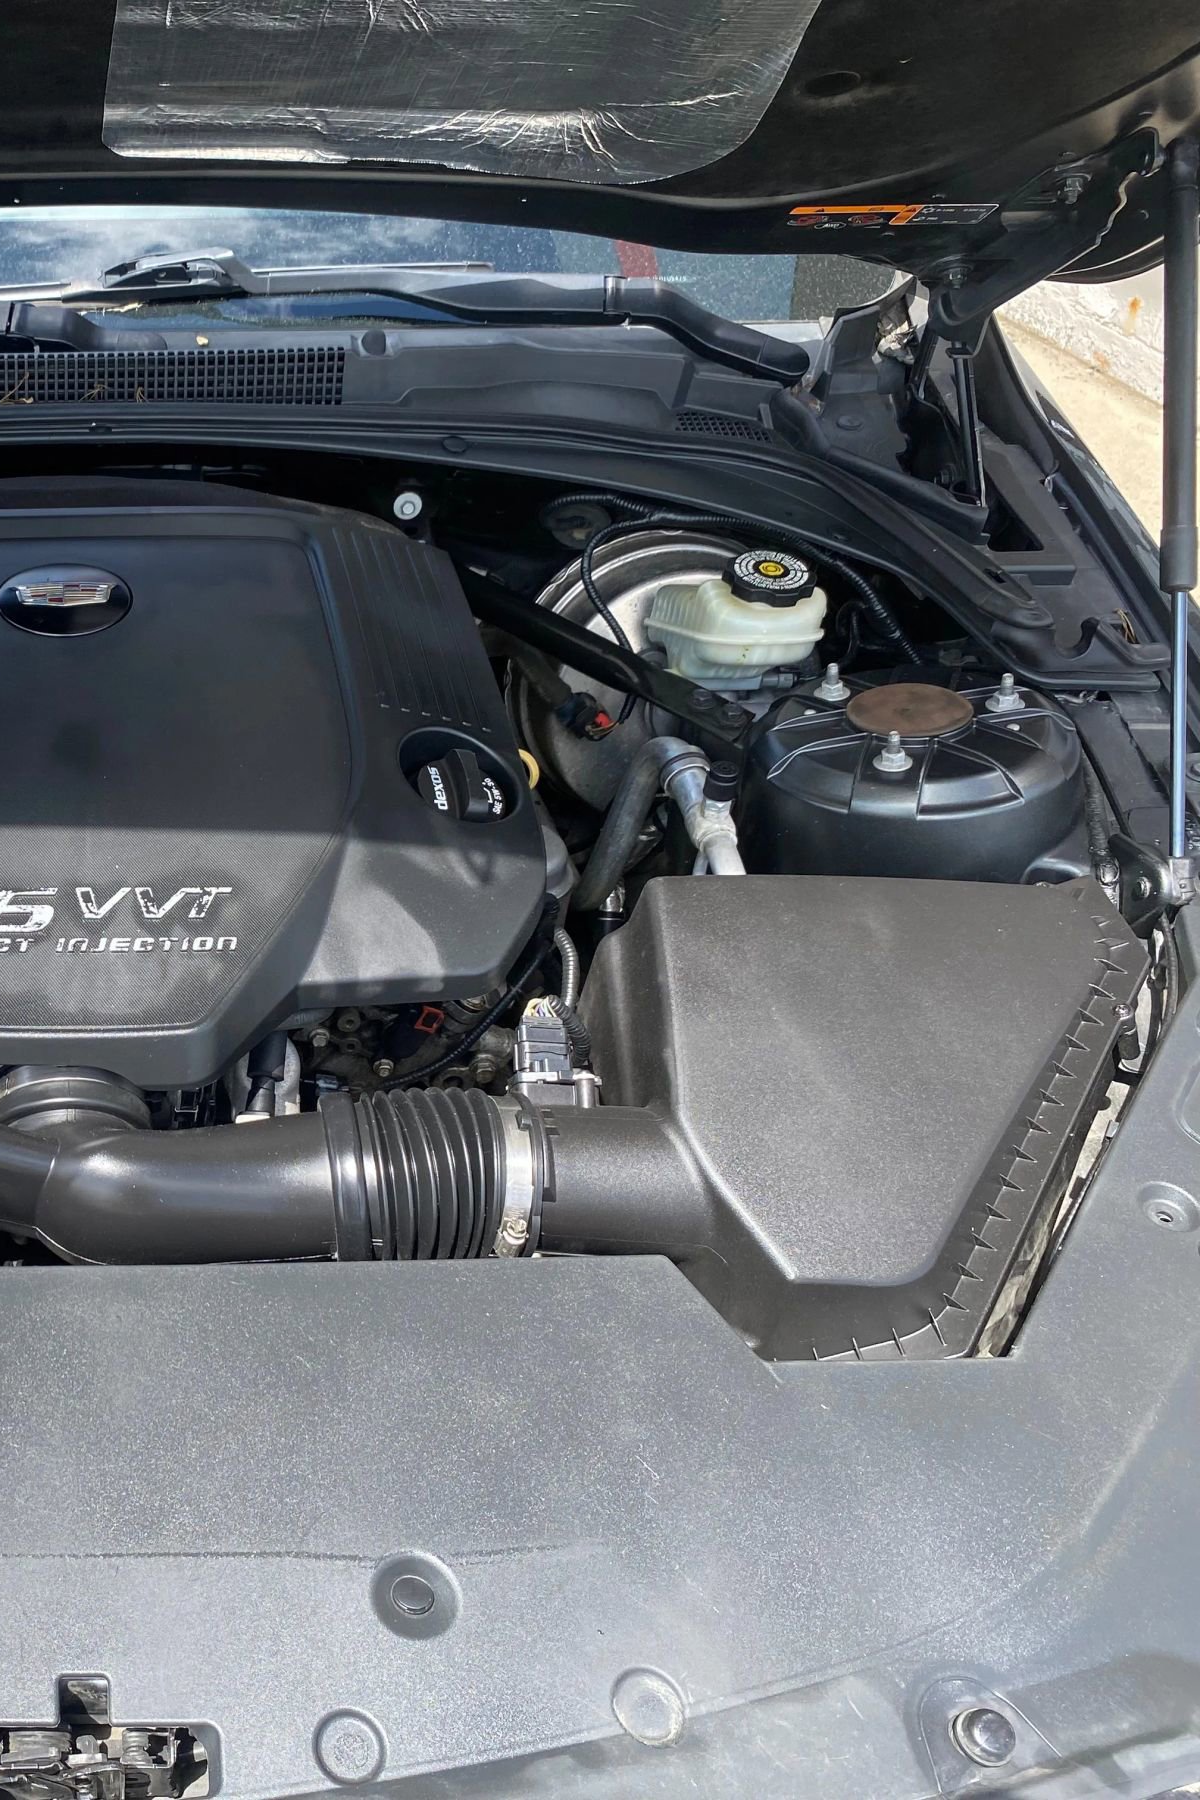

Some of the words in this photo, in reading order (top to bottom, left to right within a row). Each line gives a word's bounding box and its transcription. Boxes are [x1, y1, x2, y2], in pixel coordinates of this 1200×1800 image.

[427, 765, 448, 810] dexos
[492, 800, 502, 815] SAE
[75, 886, 233, 920] VVT
[55, 936, 238, 953] INJECTION
